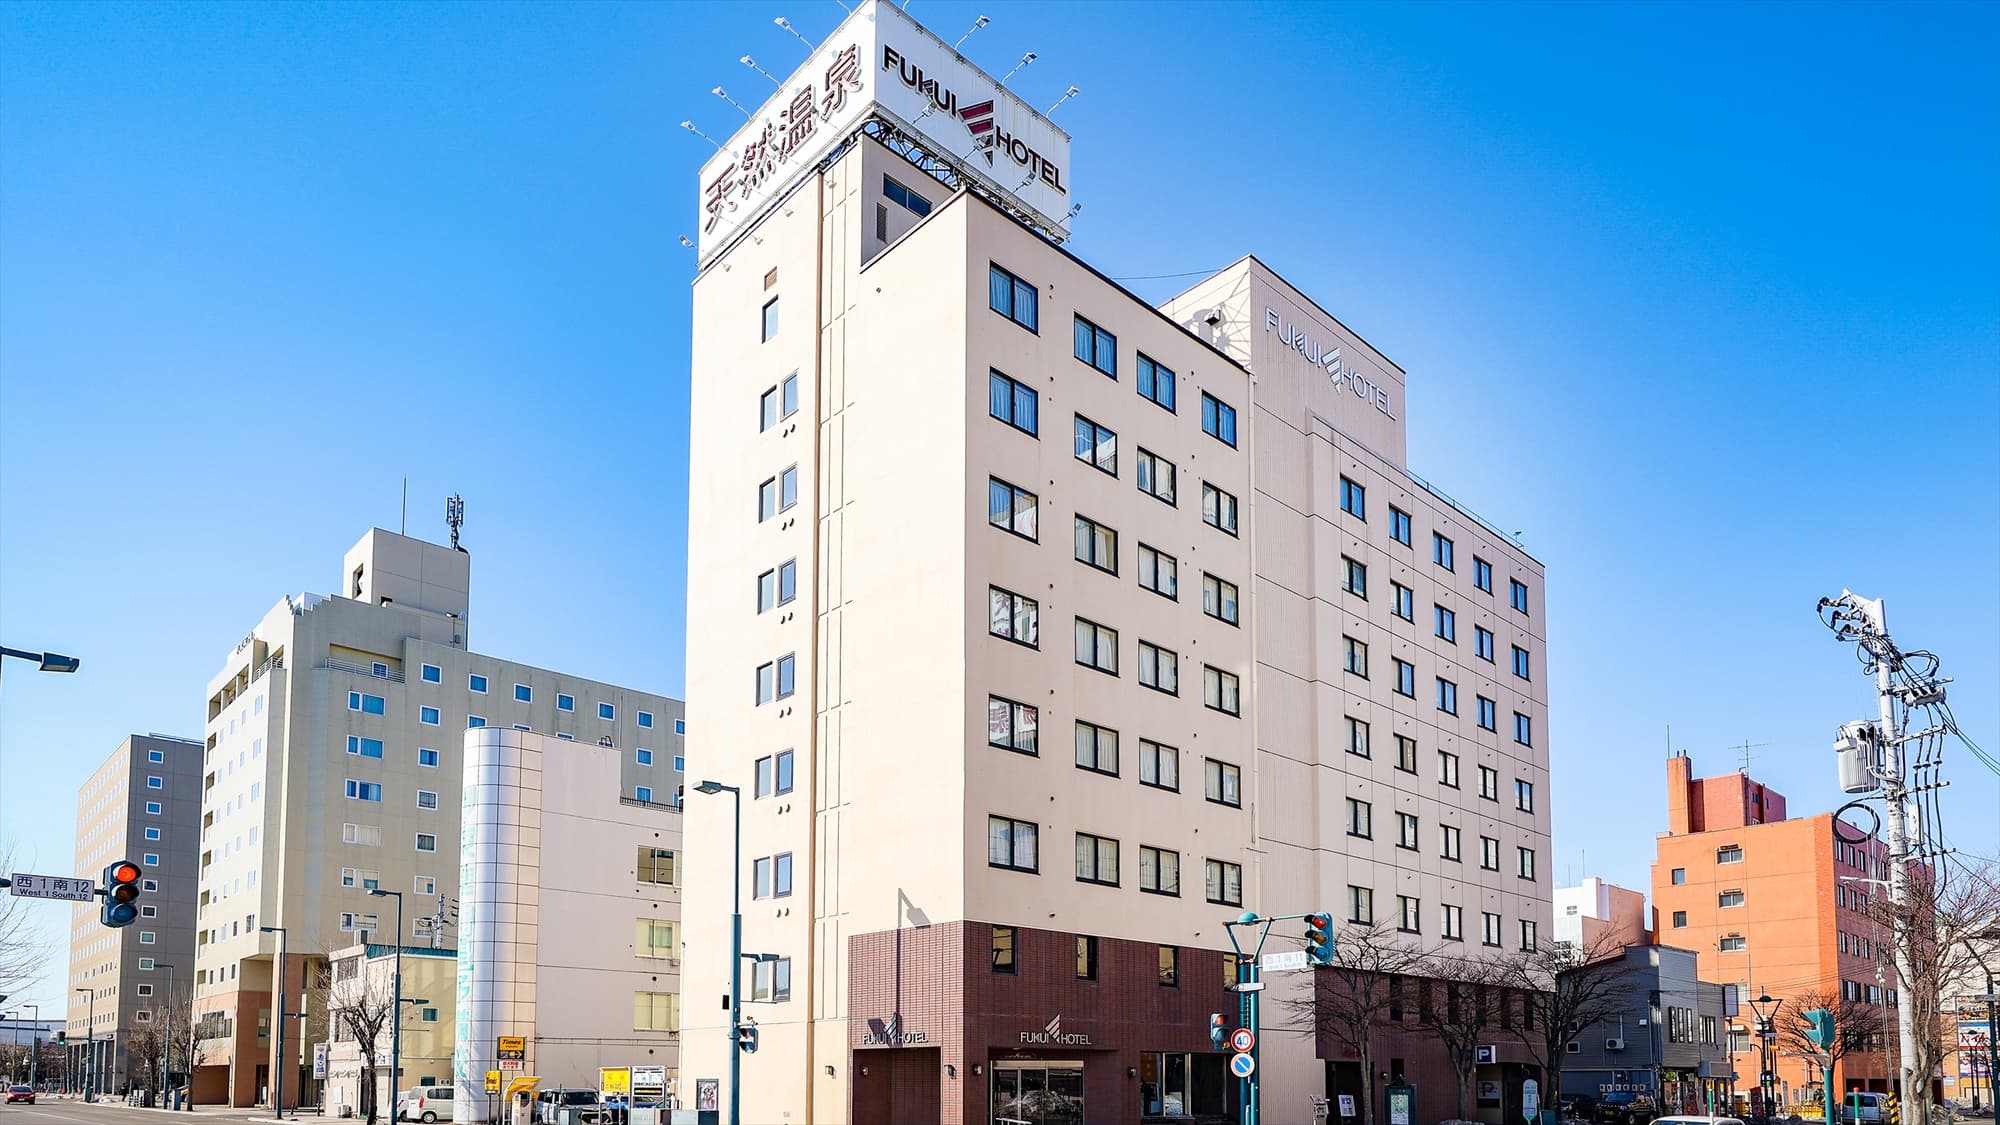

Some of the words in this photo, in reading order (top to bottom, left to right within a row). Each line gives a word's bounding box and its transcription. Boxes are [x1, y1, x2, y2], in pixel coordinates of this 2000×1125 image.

[882, 44, 957, 118] FUKUI
[995, 125, 1067, 196] HOTEL
[704, 43, 863, 233] 天然温泉
[1264, 306, 1322, 368] FUKUI
[1340, 361, 1397, 422] HOTEL
[19, 888, 41, 897] West
[51, 890, 76, 900] South
[863, 1032, 889, 1045] FUKUI
[897, 1031, 928, 1044] HOTEL
[1020, 1031, 1050, 1044] FUKUI
[1060, 1033, 1092, 1045] HOTEL
[1236, 1035, 1248, 1045] 40
[1478, 1048, 1490, 1060] P
